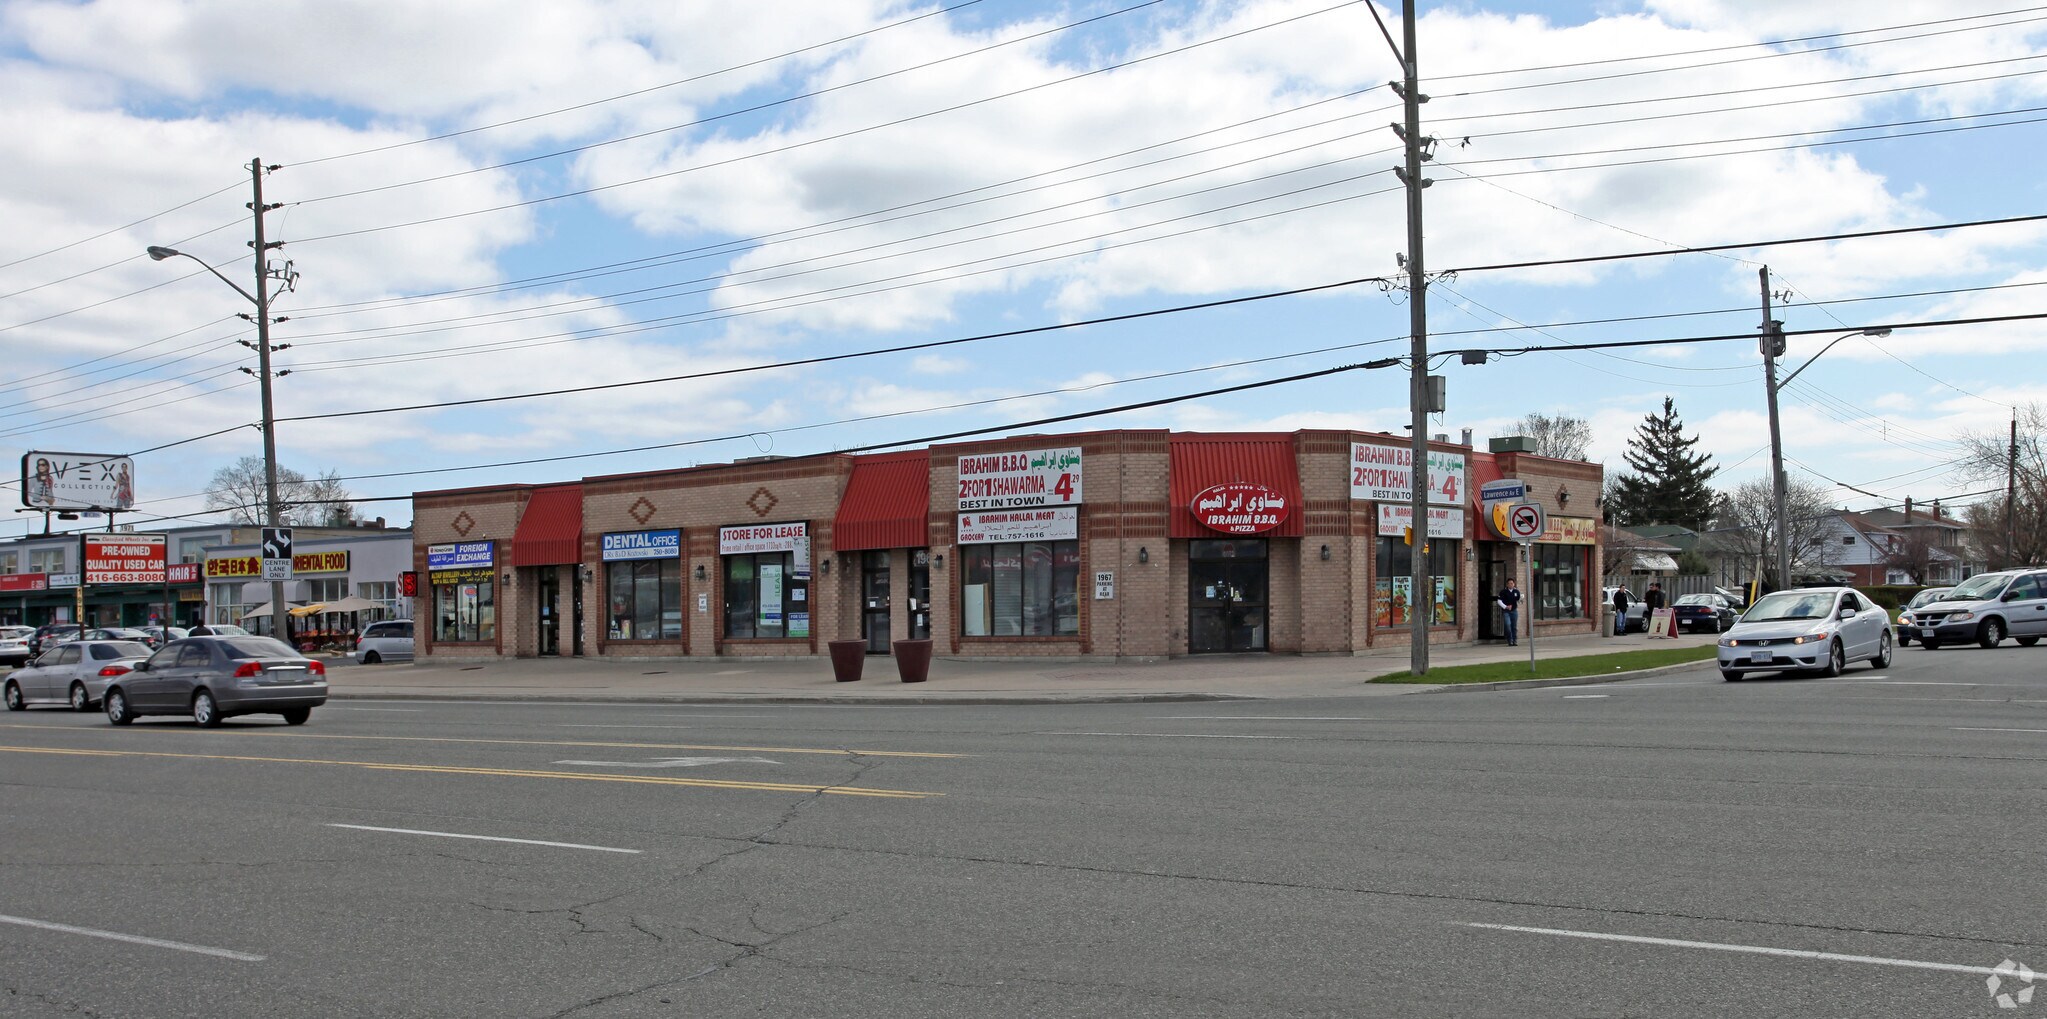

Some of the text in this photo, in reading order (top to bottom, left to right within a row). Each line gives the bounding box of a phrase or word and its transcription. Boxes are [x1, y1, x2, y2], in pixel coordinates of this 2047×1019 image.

[1355, 445, 1395, 465] IBRAHIM
[960, 455, 1000, 475] IBRAHIM
[52, 461, 116, 481] VEX
[1372, 489, 1392, 499] BEST
[1391, 491, 1399, 499] IN
[1483, 491, 1509, 499] Lawrence
[960, 496, 1045, 508] BEST IN TOWN
[978, 511, 1055, 524] IBRAHIM HALLAL MEAT
[1395, 507, 1413, 517] IBRAHI
[1208, 515, 1252, 525] IBRAHIM
[723, 526, 804, 541] STORE FOR LEASE
[605, 534, 677, 549] DENTAL OFFICE
[102, 545, 150, 556] PRE-OWNED
[459, 544, 488, 553] FOREIGN
[325, 553, 346, 570] FOOD
[456, 552, 491, 562] EXCHANGE
[86, 560, 165, 570] QUALITY USED CAR
[86, 573, 165, 582] 416-663-8080
[169, 566, 190, 580] HAIR
